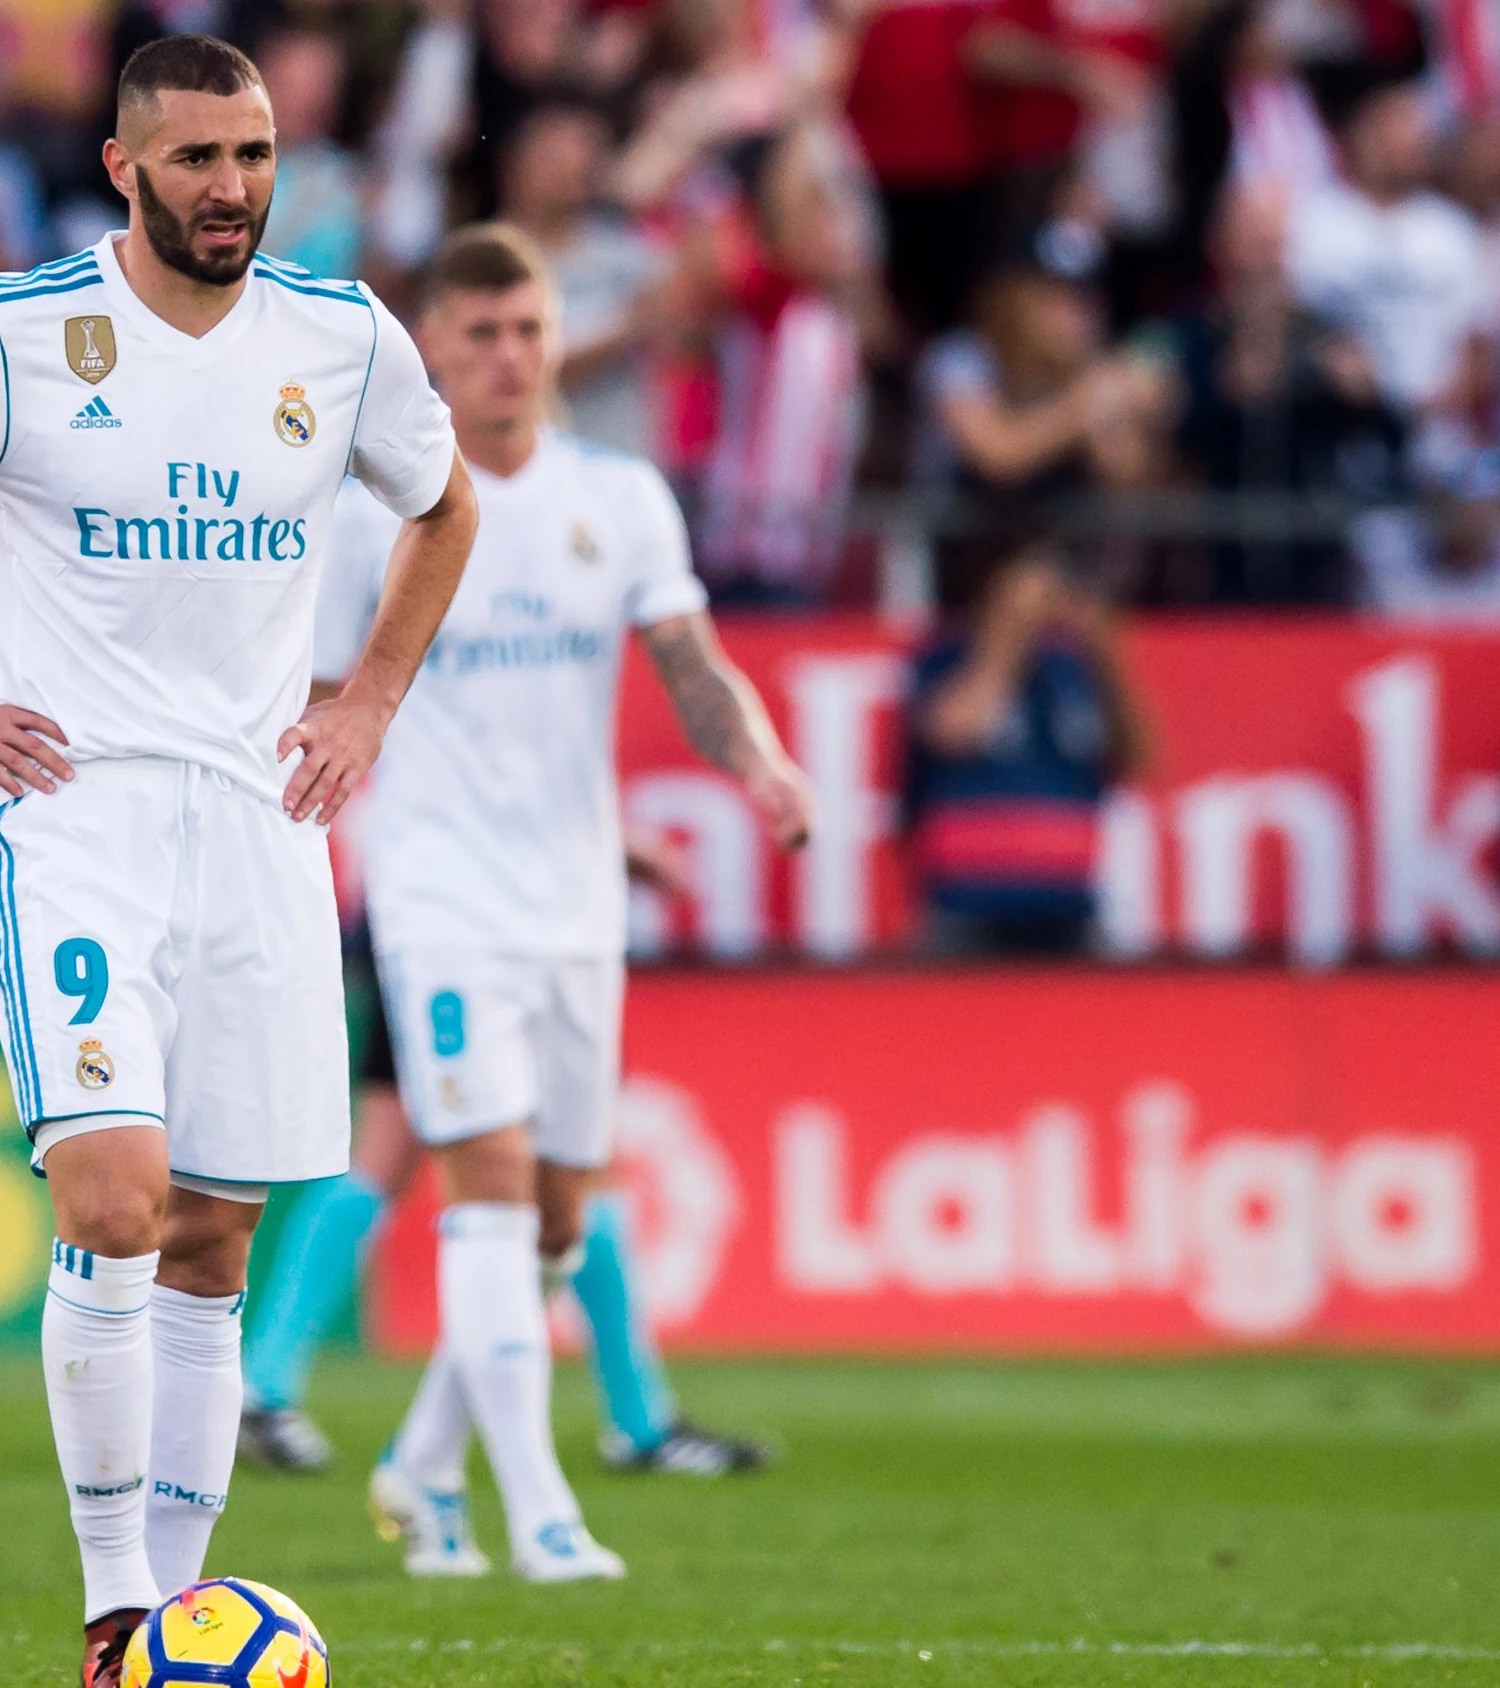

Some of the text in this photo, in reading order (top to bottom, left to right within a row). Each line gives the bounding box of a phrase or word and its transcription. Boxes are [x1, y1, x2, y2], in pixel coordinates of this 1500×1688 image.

[80, 358, 106, 369] FIFA
[70, 416, 123, 429] adidas
[167, 463, 240, 507] Fly
[73, 504, 306, 560] Emirates
[53, 937, 109, 1026] 9
[430, 991, 465, 1057] 8
[773, 1082, 1480, 1340] LaLiga
